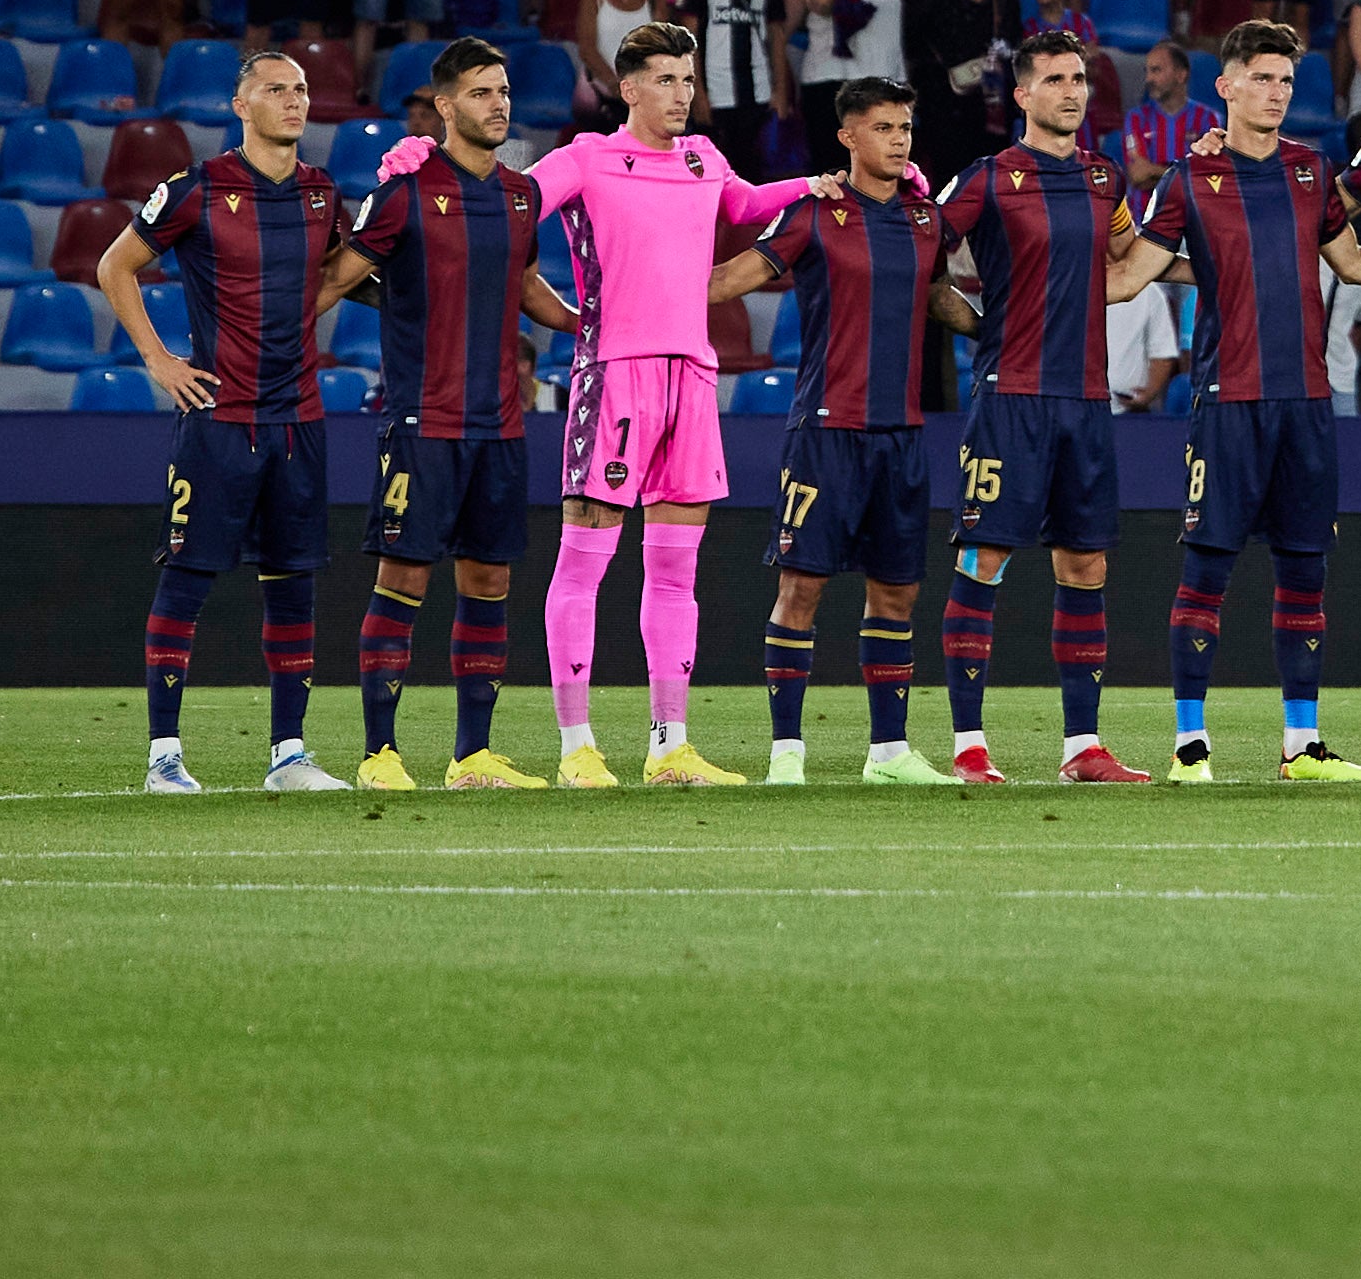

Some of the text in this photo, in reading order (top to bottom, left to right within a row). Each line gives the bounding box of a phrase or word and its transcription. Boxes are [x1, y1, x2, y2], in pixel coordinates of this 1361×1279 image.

[615, 417, 630, 457] 1
[170, 478, 192, 525] 2
[383, 471, 410, 516] 4
[965, 458, 1003, 503] 15
[1189, 458, 1206, 503] 8
[782, 481, 819, 528] 17
